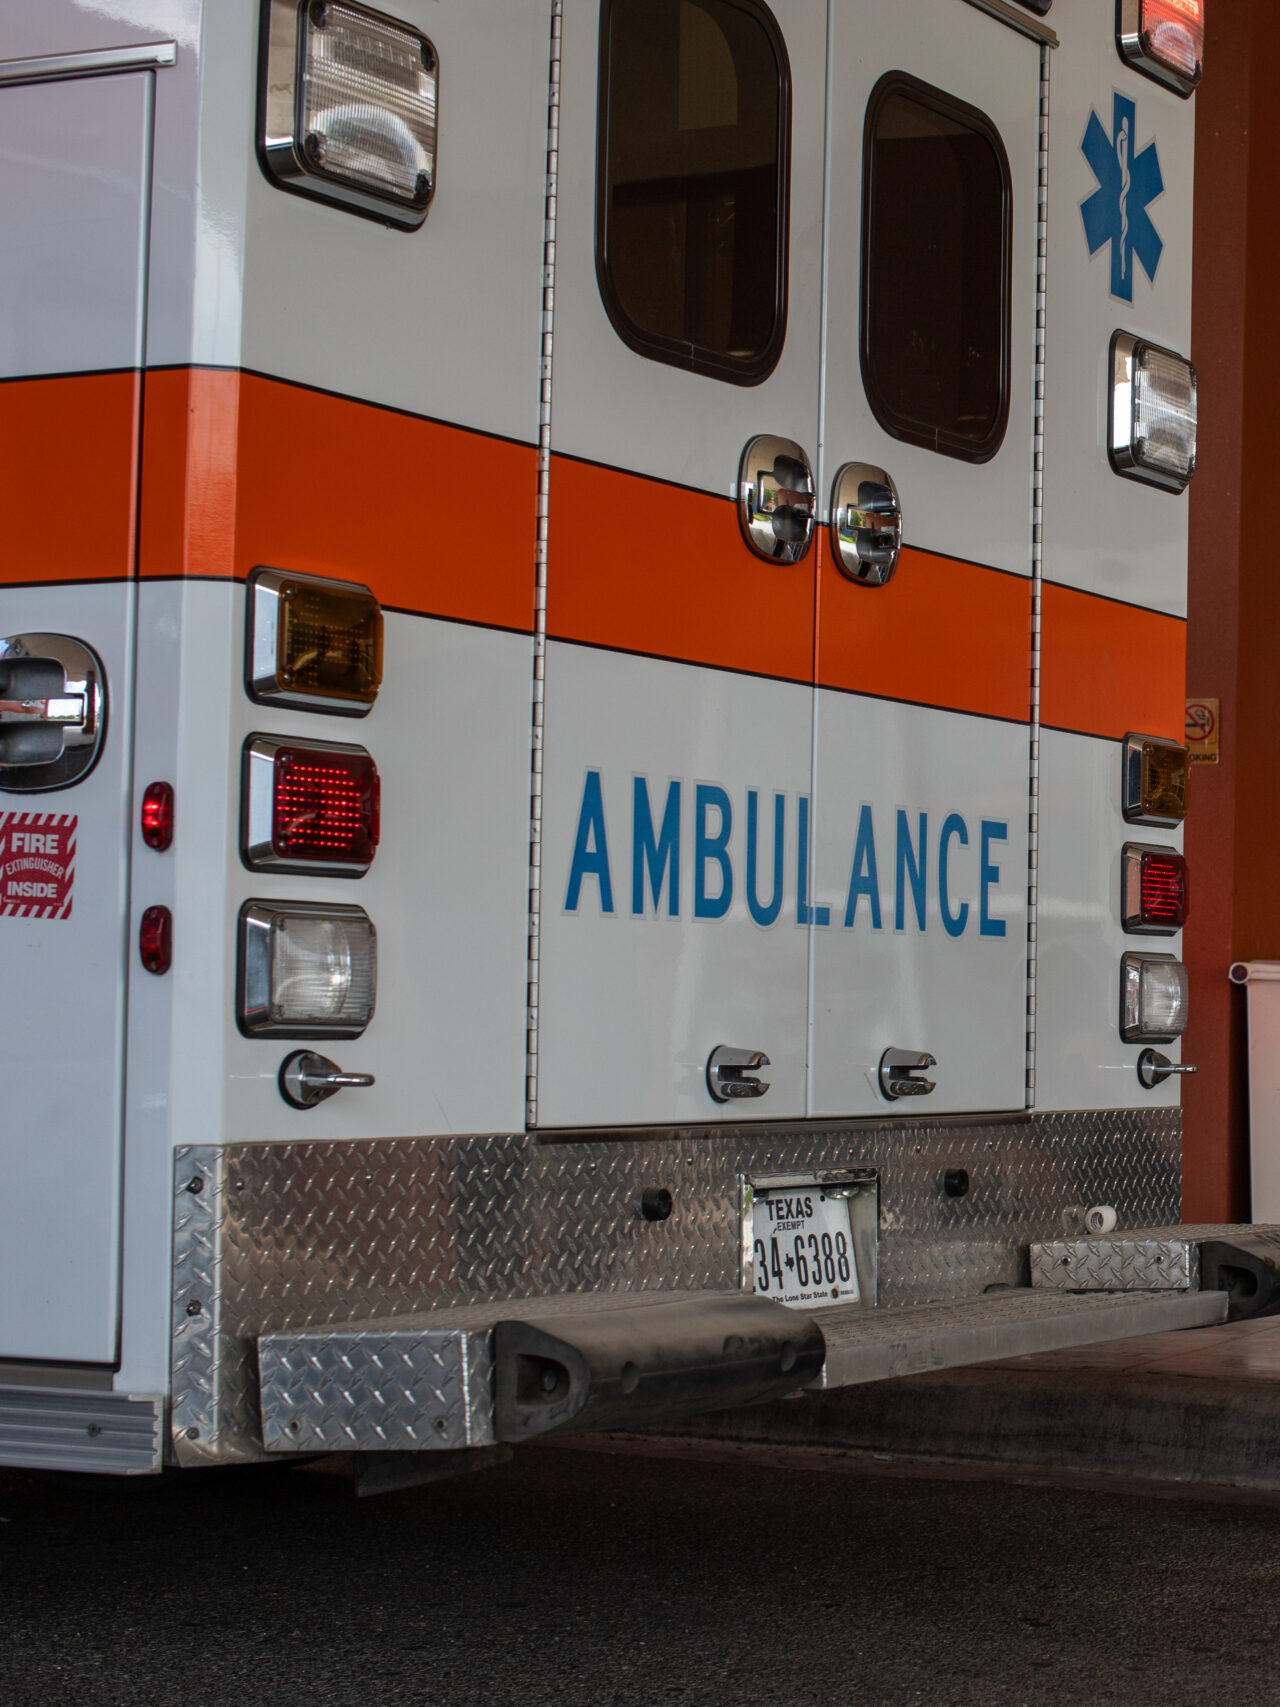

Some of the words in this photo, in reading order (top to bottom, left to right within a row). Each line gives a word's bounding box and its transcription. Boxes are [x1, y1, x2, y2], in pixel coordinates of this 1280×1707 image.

[11, 832, 60, 854] FIRE
[562, 768, 1009, 939] AMBULANCE
[6, 856, 64, 879] EXTINGUISHER
[7, 881, 58, 898] INSIDE
[766, 1196, 813, 1221] TEXAS
[776, 1220, 805, 1231] EXEMPT
[753, 1237, 784, 1292] 34
[794, 1231, 850, 1287] 6388
[785, 1294, 799, 1302] Lone
